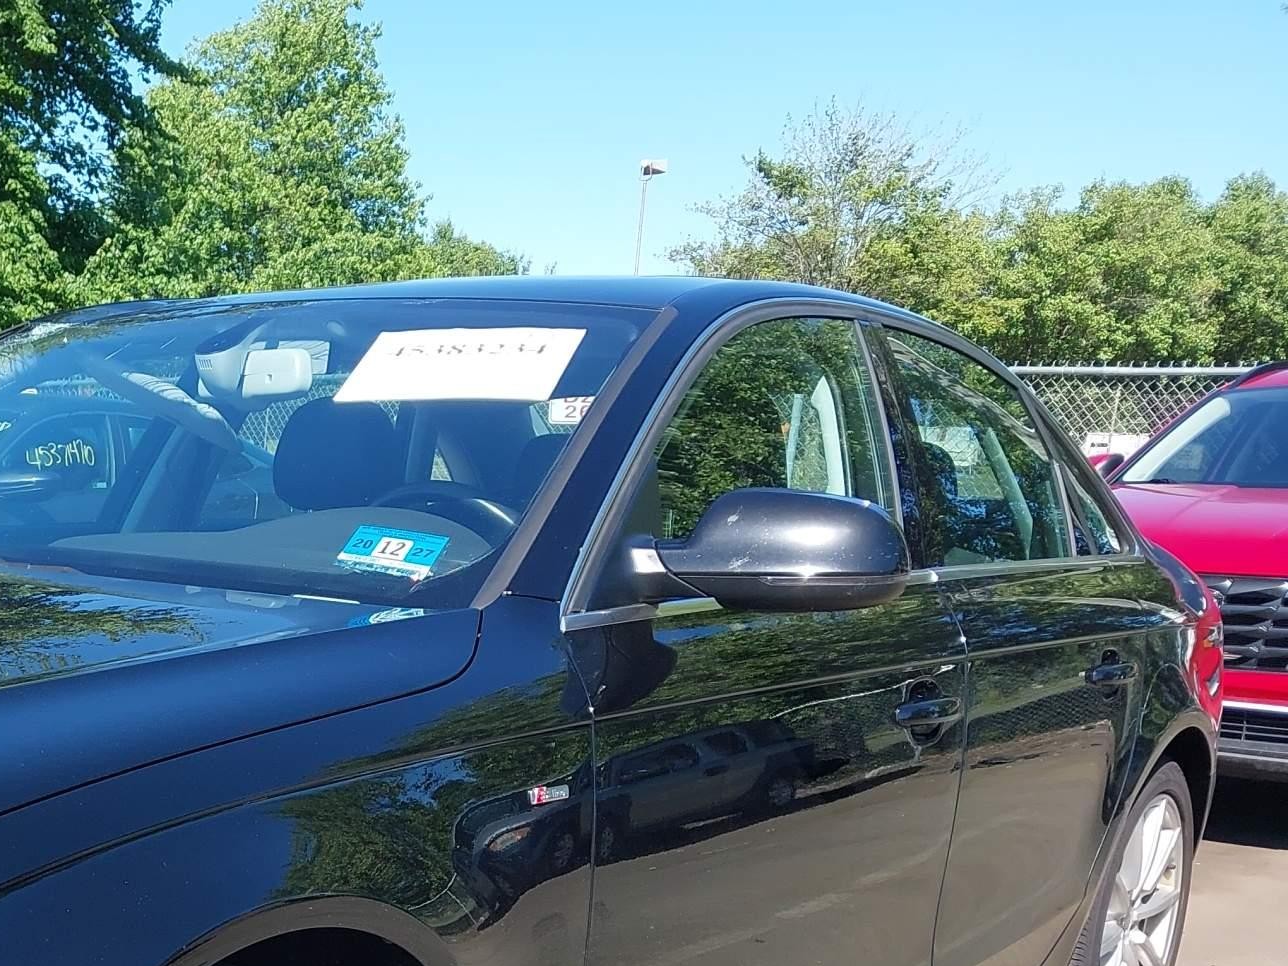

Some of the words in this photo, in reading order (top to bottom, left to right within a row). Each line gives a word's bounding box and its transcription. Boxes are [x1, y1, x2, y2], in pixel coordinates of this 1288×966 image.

[351, 539, 374, 550] 20
[377, 540, 407, 556] 12
[412, 547, 436, 558] 27
